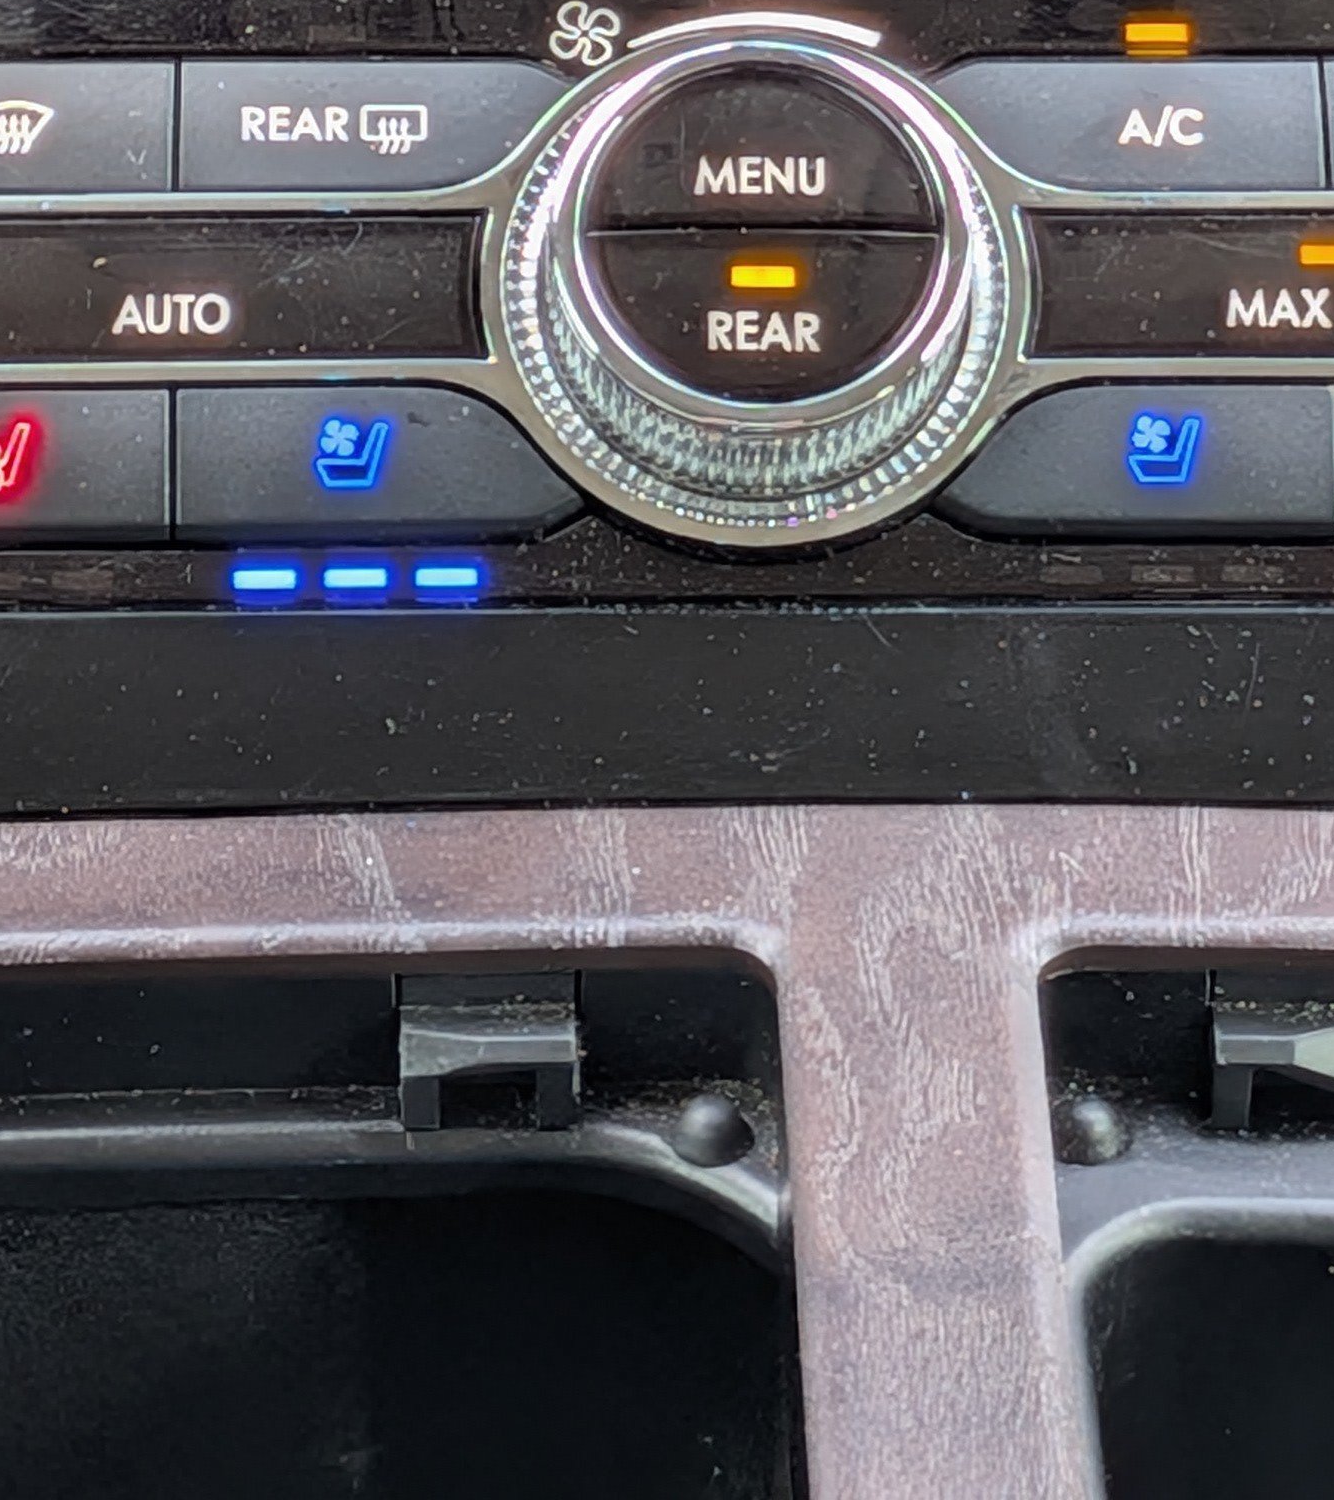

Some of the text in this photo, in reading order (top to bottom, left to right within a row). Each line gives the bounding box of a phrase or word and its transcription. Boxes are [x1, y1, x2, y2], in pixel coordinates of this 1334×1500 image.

[240, 105, 350, 143] REAR
[1118, 104, 1205, 147] A/C
[693, 156, 826, 196] MENU
[111, 292, 232, 335] AUTO
[1225, 287, 1328, 329] MAX
[707, 310, 822, 353] REAR
